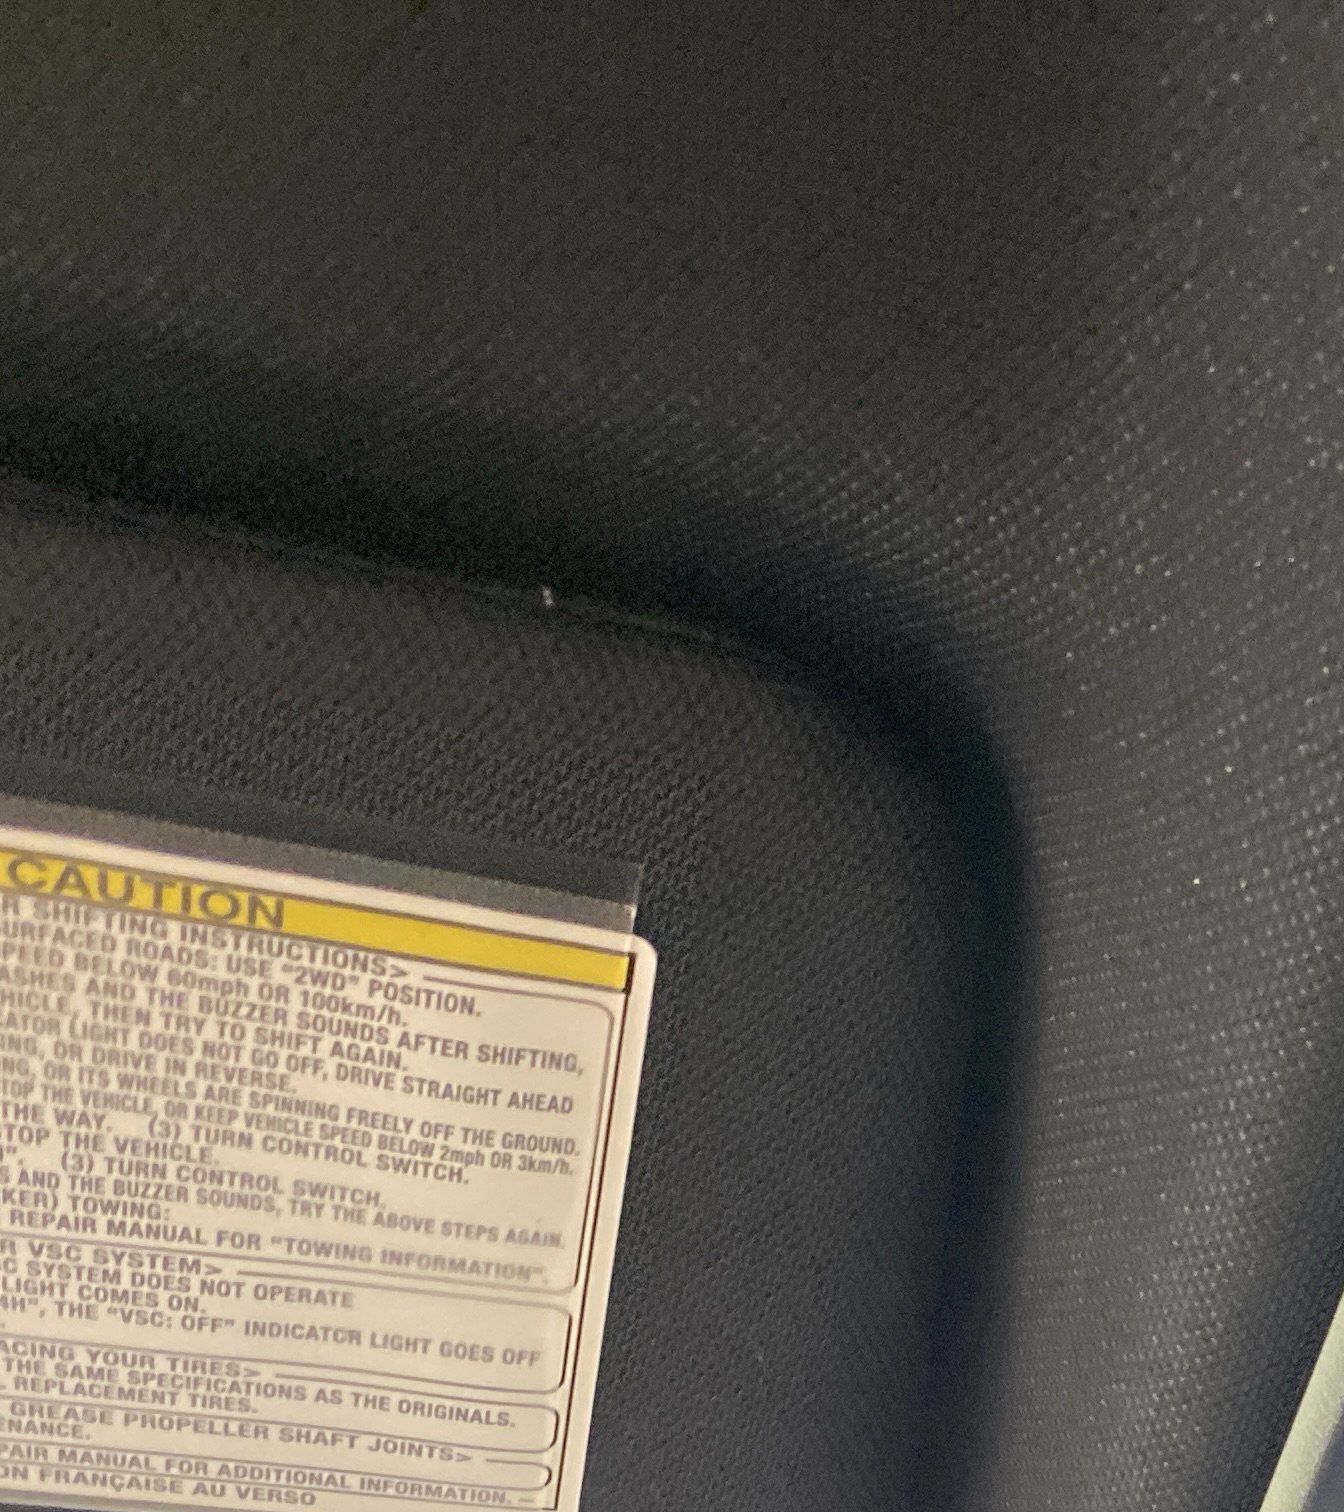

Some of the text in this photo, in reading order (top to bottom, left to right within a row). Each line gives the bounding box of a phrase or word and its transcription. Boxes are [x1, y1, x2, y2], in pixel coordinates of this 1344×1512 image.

[7, 856, 285, 929] CAUTION
[33, 898, 168, 940] SHIFTING
[73, 952, 158, 984] BELOW
[256, 982, 291, 1005] OR
[298, 989, 409, 1026] 100km/h.
[125, 937, 218, 970] ROADS:
[225, 953, 273, 979] USE
[367, 978, 483, 1017] POSITION.
[84, 976, 136, 1003] AND
[146, 986, 189, 1011] THE
[197, 994, 289, 1026] BUZZER
[295, 1010, 389, 1045] SOUNDS
[396, 1029, 470, 1059] AFTER
[476, 1042, 585, 1077] SHIFTING,
[89, 1000, 150, 1027] THEN
[159, 1011, 206, 1036] TRY
[217, 1020, 246, 1042] TO
[252, 1026, 320, 1055] SHIFT
[328, 1039, 411, 1070] AGAIN.
[52, 1040, 83, 1061] OR
[91, 1046, 156, 1072] DRIVE
[163, 1056, 187, 1076] IN
[194, 1061, 298, 1093] REVERSE.
[70, 1020, 129, 1047] LIGHT
[137, 1031, 194, 1057] DOES
[200, 1041, 242, 1064] NOT
[249, 1048, 279, 1069] GO
[285, 1054, 329, 1081] OFF,
[334, 1062, 395, 1089] DRIVE
[401, 1073, 502, 1108] STRAIGHT
[506, 1091, 574, 1115] AHEAD
[40, 1082, 75, 1103] THE
[163, 1099, 188, 1118] OR
[194, 1104, 239, 1124] KEEP
[243, 1111, 313, 1136] VEHICLE
[318, 1122, 372, 1147] SPEED
[376, 1132, 435, 1159] BELOW
[438, 1142, 486, 1168] 2mph
[489, 1149, 514, 1169] OR
[517, 1153, 574, 1176] 3km/h.
[42, 1061, 72, 1083] OR
[78, 1066, 110, 1088] ITS
[115, 1071, 198, 1100] WHEELS
[203, 1084, 243, 1106] ARE
[248, 1090, 340, 1122] SPINNING
[344, 1106, 414, 1136] FREELY
[418, 1119, 455, 1141] OFF
[459, 1124, 495, 1146] THE
[501, 1130, 581, 1157] GROUND.
[0, 1099, 471, 1185] THE WAY. (3) TURN CONTROL SWITCH.
[58, 1129, 106, 1153] THE
[113, 1136, 222, 1167] VEHICLE.
[60, 1150, 389, 1209] (3) TURN CONTROL SWITCH.
[69, 1194, 171, 1221] TOWING:
[9, 1208, 97, 1234] REPAIR
[105, 1218, 208, 1245] MANUAL
[214, 1230, 262, 1250] FOR
[17, 1168, 60, 1189] AND
[68, 1174, 107, 1195] THE
[112, 1179, 189, 1204] BUZZER
[195, 1188, 282, 1217] SOUNDS,
[289, 1200, 326, 1220] TRY
[331, 1205, 367, 1226] THE
[371, 1210, 436, 1234] ABOVE
[440, 1219, 499, 1242] STEPS
[503, 1227, 567, 1249] AGAIN.
[26, 1259, 122, 1285] SYSTEM
[129, 1270, 192, 1292] DOES
[198, 1277, 245, 1298] NOT
[252, 1283, 354, 1309] OPERATE
[27, 1240, 82, 1262] VSC
[92, 1247, 223, 1277] SYSTEM>
[0, 1275, 208, 1314] LIGHT COMES ON.
[54, 1300, 100, 1320] THE
[243, 1320, 363, 1347] INDICATOR
[368, 1332, 432, 1355] LIGHT
[438, 1340, 495, 1362] GOES
[500, 1347, 541, 1367] OFF
[85, 1347, 156, 1369] YOUR
[165, 1356, 261, 1380] TIRES>
[4, 1357, 517, 1428] THE SAME SPECIFICATIONS AS THE ORIGINALS.
[13, 1376, 259, 1414] REPLACEMENT TIRES.
[9, 1401, 115, 1425] GREASE
[122, 1412, 270, 1440] PROPELLER
[278, 1427, 360, 1449] SHAFT
[39, 1467, 184, 1494] FRANÇAISE
[191, 1481, 227, 1498] AU
[234, 1485, 316, 1506] VERSO
[57, 1449, 157, 1471] MANUAL
[164, 1458, 209, 1475] FOR
[216, 1463, 352, 1489] ADDITIONAL
[359, 1476, 512, 1504] INFORMATION.
